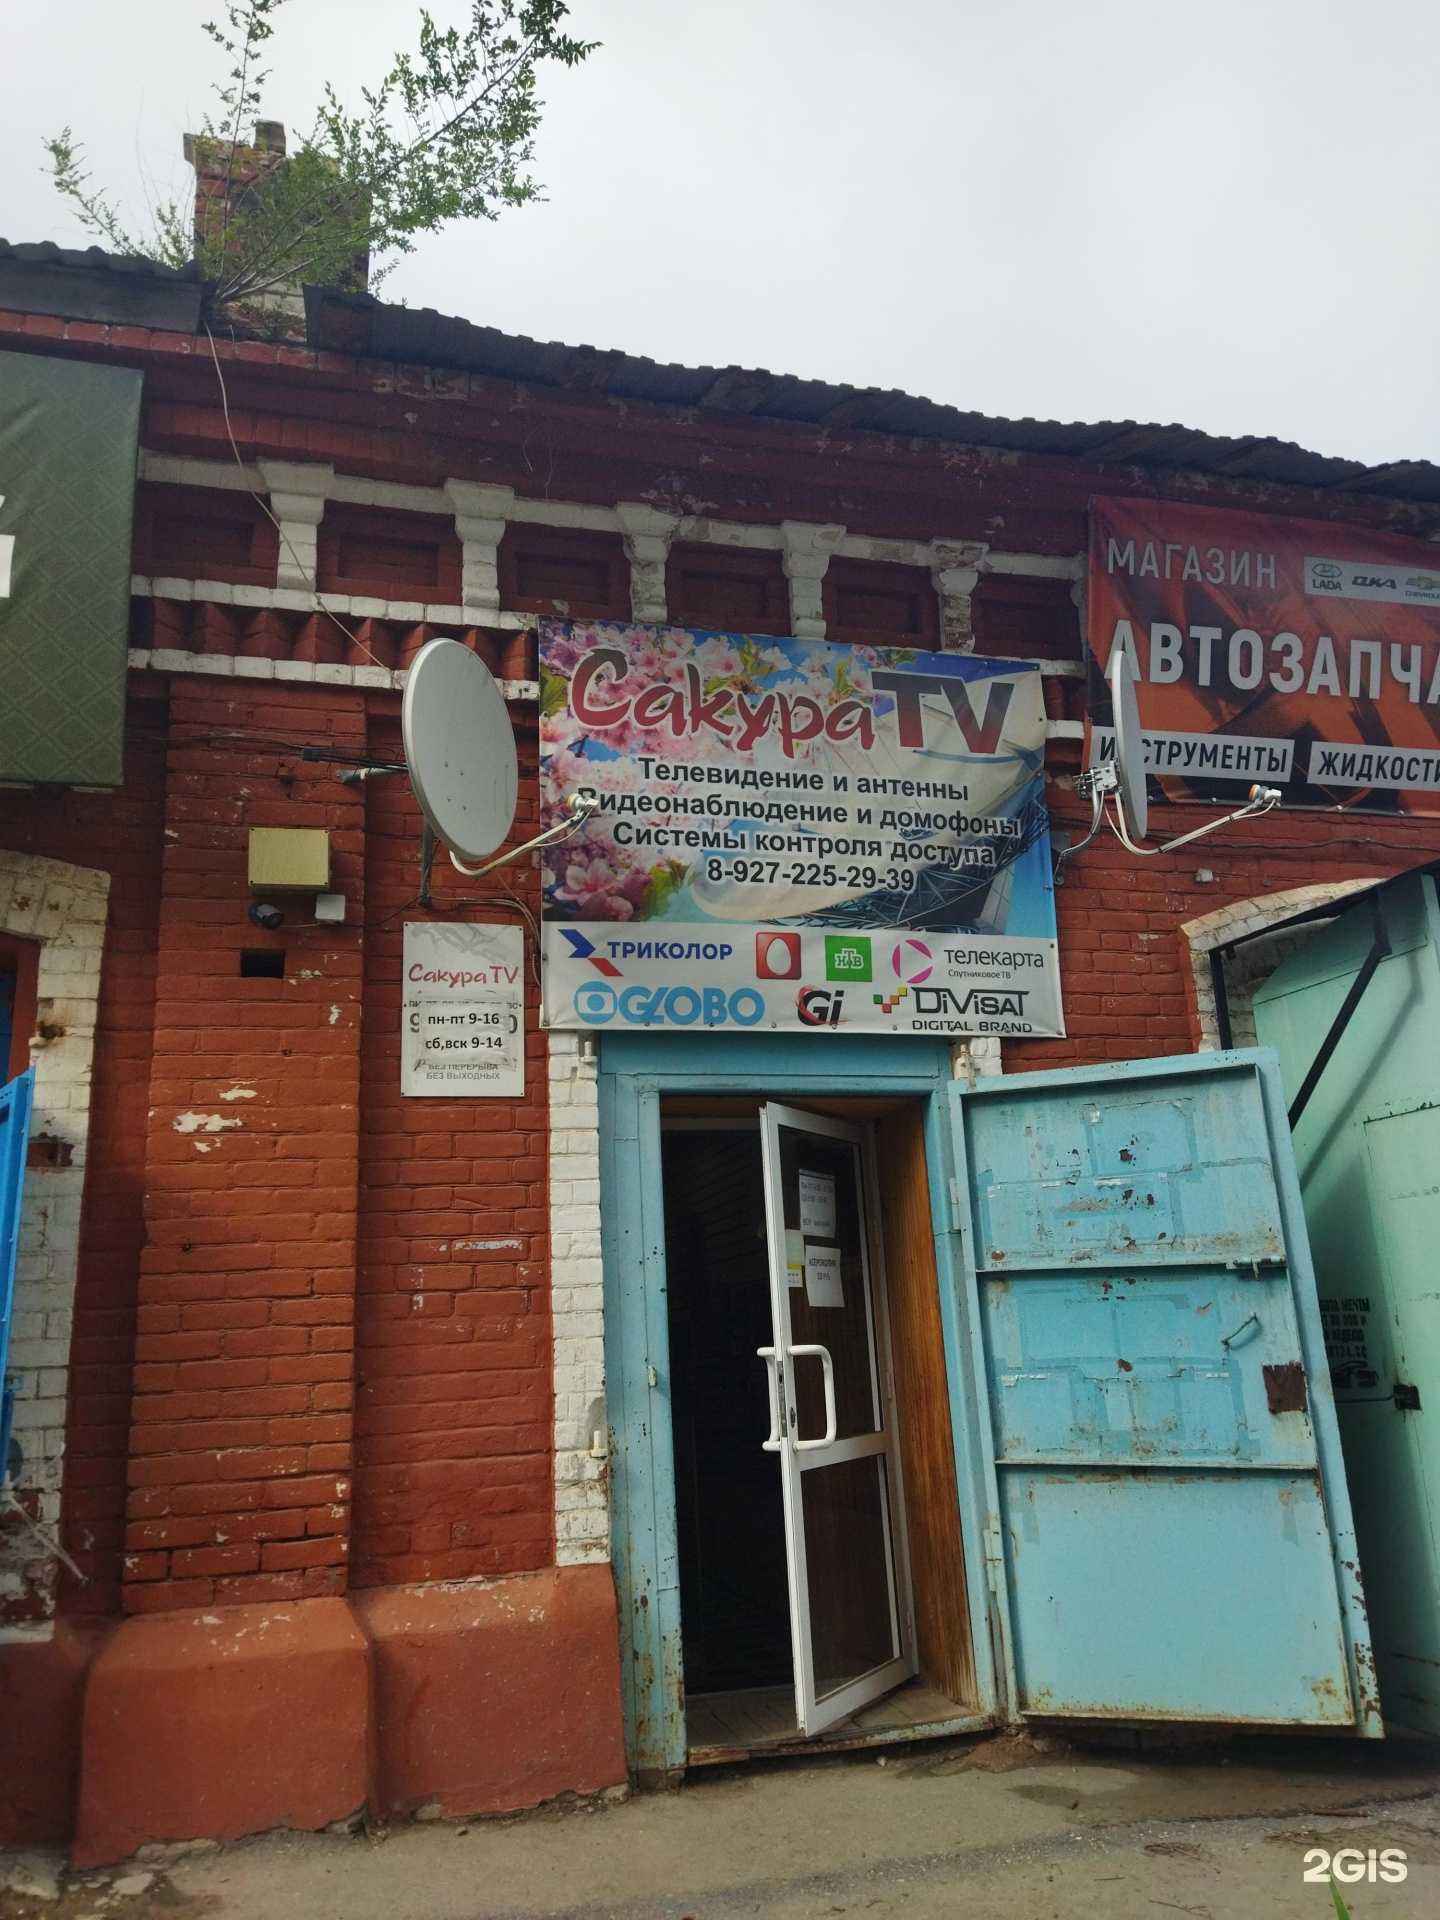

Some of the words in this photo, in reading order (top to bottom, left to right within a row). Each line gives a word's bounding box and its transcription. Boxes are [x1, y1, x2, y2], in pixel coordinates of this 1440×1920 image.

[1107, 538, 1276, 589] МАГАЗИН
[1312, 579, 1342, 591] LADA
[571, 648, 876, 758] Сакура
[871, 671, 1016, 753] TV
[1100, 736, 1287, 773] ИТРУМЕНТЫ
[638, 757, 823, 790] Телевидение
[833, 776, 848, 791] и
[857, 777, 968, 800] антенны
[857, 808, 871, 824] и
[880, 809, 1019, 837] домофоны
[613, 822, 746, 849] Системы
[756, 833, 882, 858] контроля
[891, 842, 994, 870] доступа
[708, 859, 914, 891] 8-927-225-29-39
[607, 941, 733, 960] ТРИКОЛОР
[944, 949, 1044, 970] телекарта
[408, 964, 487, 988] Сакура
[489, 966, 519, 984] TV
[948, 969, 1000, 980] Спутниковое
[619, 986, 765, 1026] GLOBO
[428, 1015, 465, 1025] пн-пт
[469, 1013, 500, 1025] 9-16
[912, 1020, 974, 1032] DIGITAL
[979, 1021, 1033, 1033] BRAND
[425, 1037, 468, 1051] сб,вск
[471, 1036, 503, 1049] 9-14
[426, 1072, 444, 1080] БЕЗ
[447, 1072, 501, 1081] ВЫХОДНЫХ
